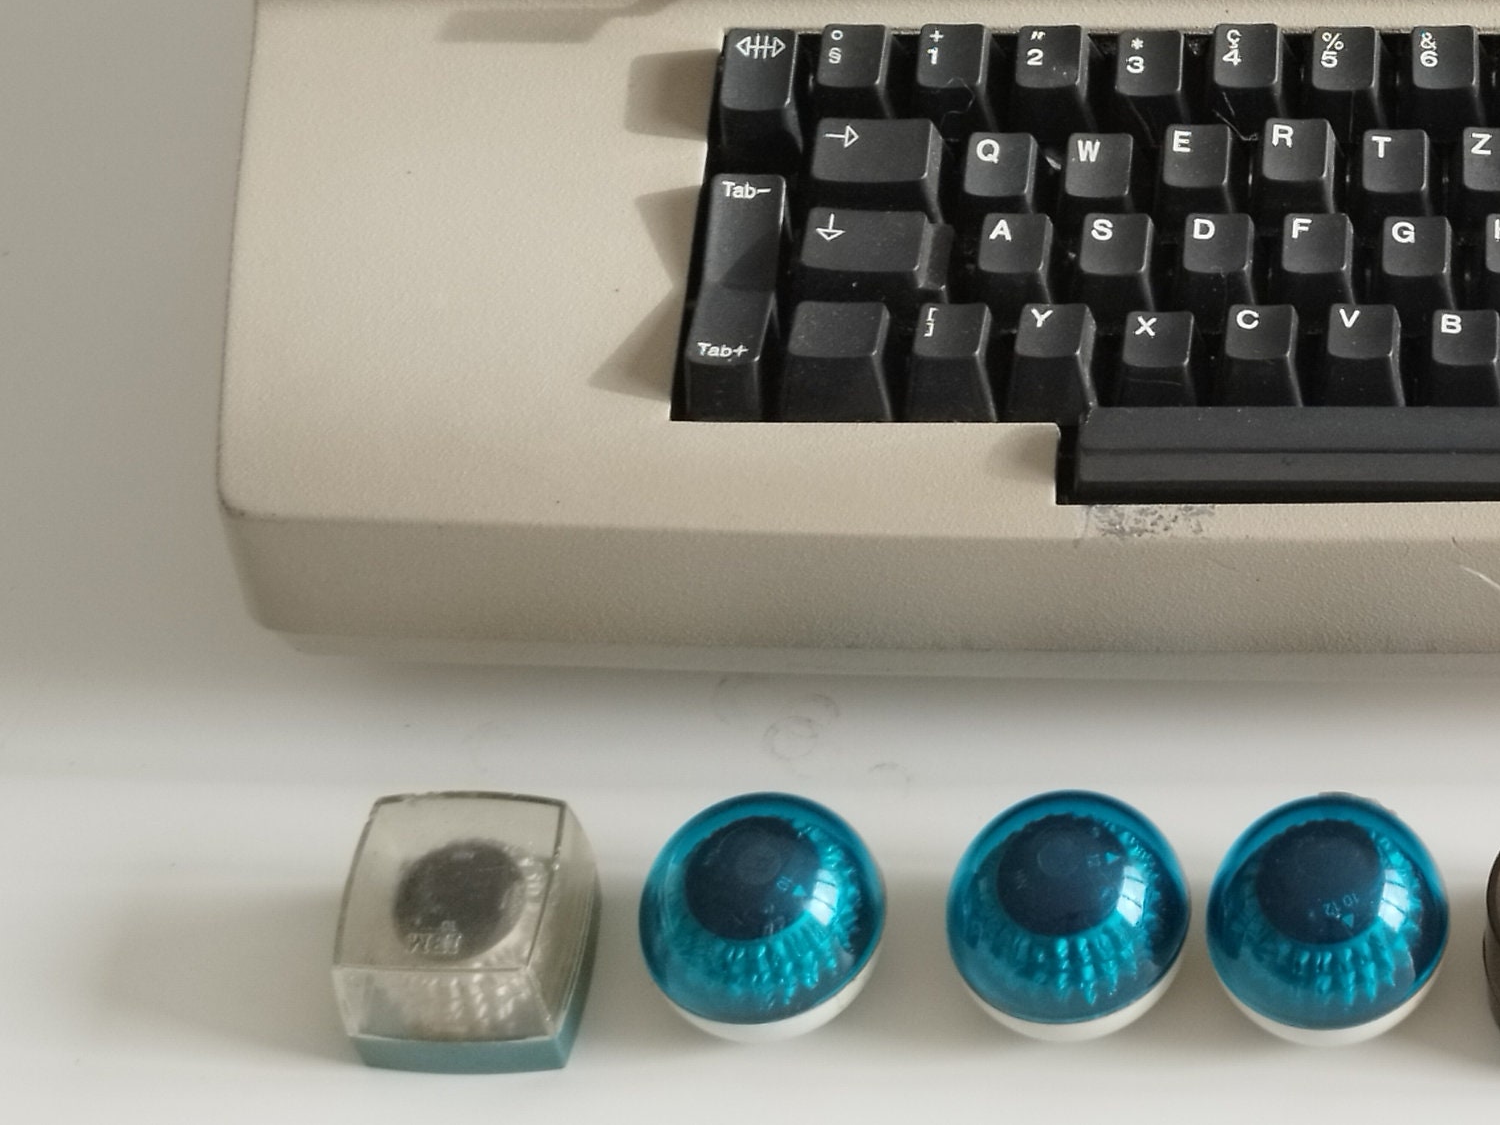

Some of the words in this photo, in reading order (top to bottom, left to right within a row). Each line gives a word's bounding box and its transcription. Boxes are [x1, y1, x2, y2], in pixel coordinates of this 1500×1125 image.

[929, 30, 945, 44] +
[1226, 29, 1242, 52] ç
[1322, 32, 1344, 51] %
[1419, 31, 1437, 50] &
[827, 47, 842, 65] §
[927, 47, 939, 65] 1
[1026, 48, 1044, 67] 2
[1126, 55, 1145, 75] 3
[1222, 48, 1241, 67] 4
[1320, 51, 1338, 69] 5
[1419, 49, 1438, 68] 6
[975, 138, 1000, 164] Q
[1076, 140, 1101, 163] W
[1172, 130, 1192, 153] E
[1272, 125, 1294, 148] R
[1371, 136, 1392, 158] T
[1470, 133, 1492, 156] Z
[988, 218, 1012, 241] A
[1090, 219, 1113, 241] S
[1192, 218, 1216, 240] D
[1291, 218, 1312, 240] F
[1391, 221, 1416, 244] G
[1030, 308, 1053, 328] Y
[1134, 316, 1158, 337] X
[1235, 310, 1260, 330] C
[1339, 308, 1360, 328] V
[1440, 313, 1462, 334] B
[697, 342, 749, 359] Tab+
